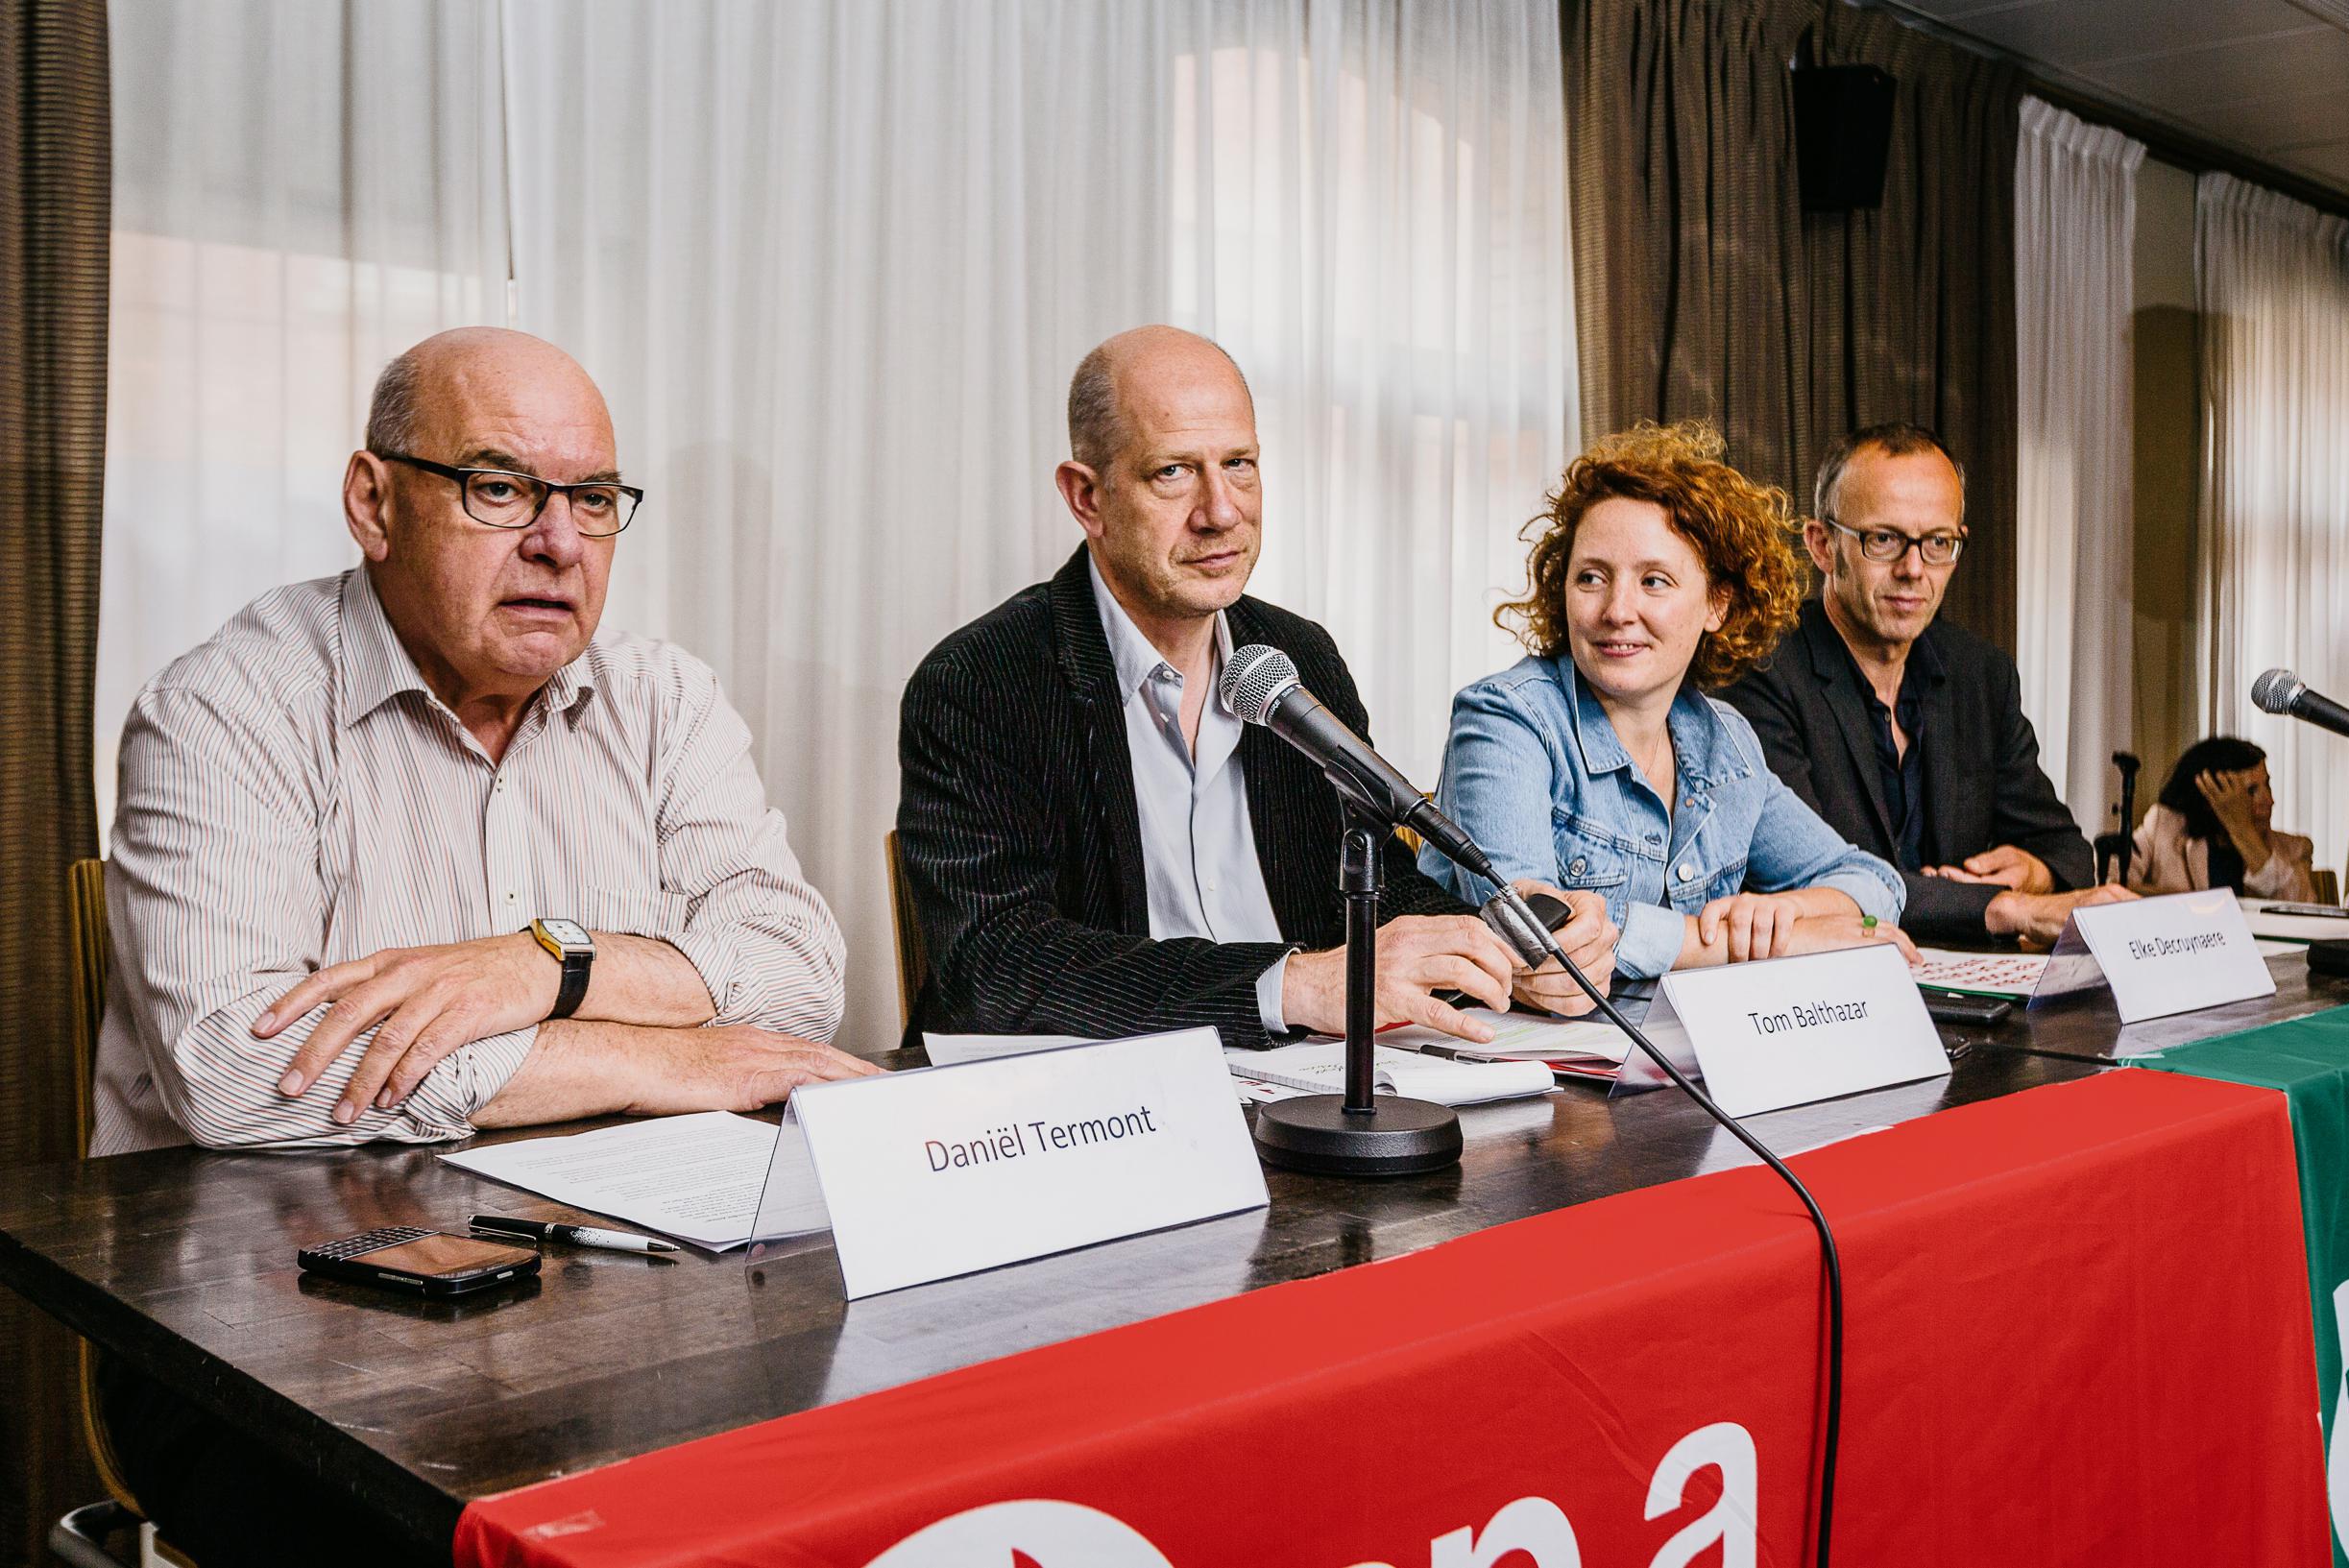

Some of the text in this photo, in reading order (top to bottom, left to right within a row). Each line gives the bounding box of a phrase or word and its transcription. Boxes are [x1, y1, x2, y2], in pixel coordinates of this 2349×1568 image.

[2128, 931, 2226, 960] Elke Decruynaere
[1747, 1000, 1869, 1035] Tom Balthazar
[924, 1105, 1157, 1172] Daniël Termont
